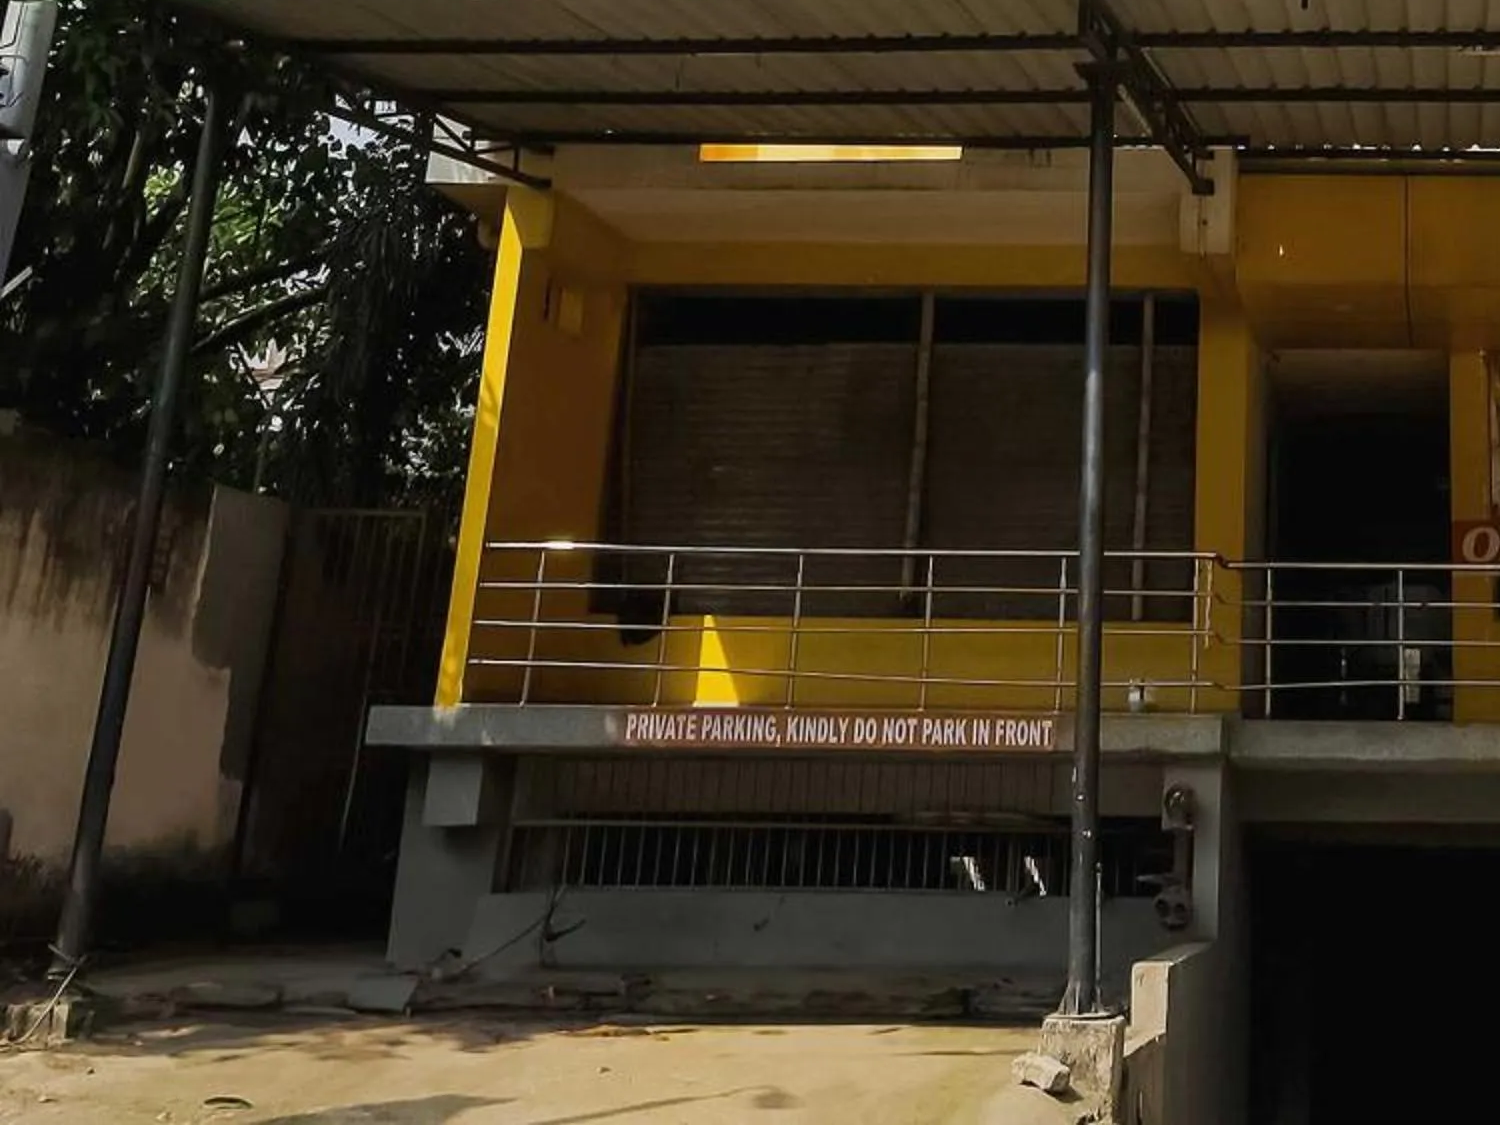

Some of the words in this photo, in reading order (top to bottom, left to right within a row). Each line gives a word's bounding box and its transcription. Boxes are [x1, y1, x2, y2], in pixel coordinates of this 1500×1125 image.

[625, 714, 697, 740] PRIVATE
[700, 715, 781, 747] PARKING,
[786, 716, 848, 744] KINDLY
[853, 718, 877, 745] DO
[881, 718, 918, 745] NOT
[922, 719, 967, 745] PARK
[971, 720, 991, 745] IN
[995, 720, 1054, 747] FRONT
